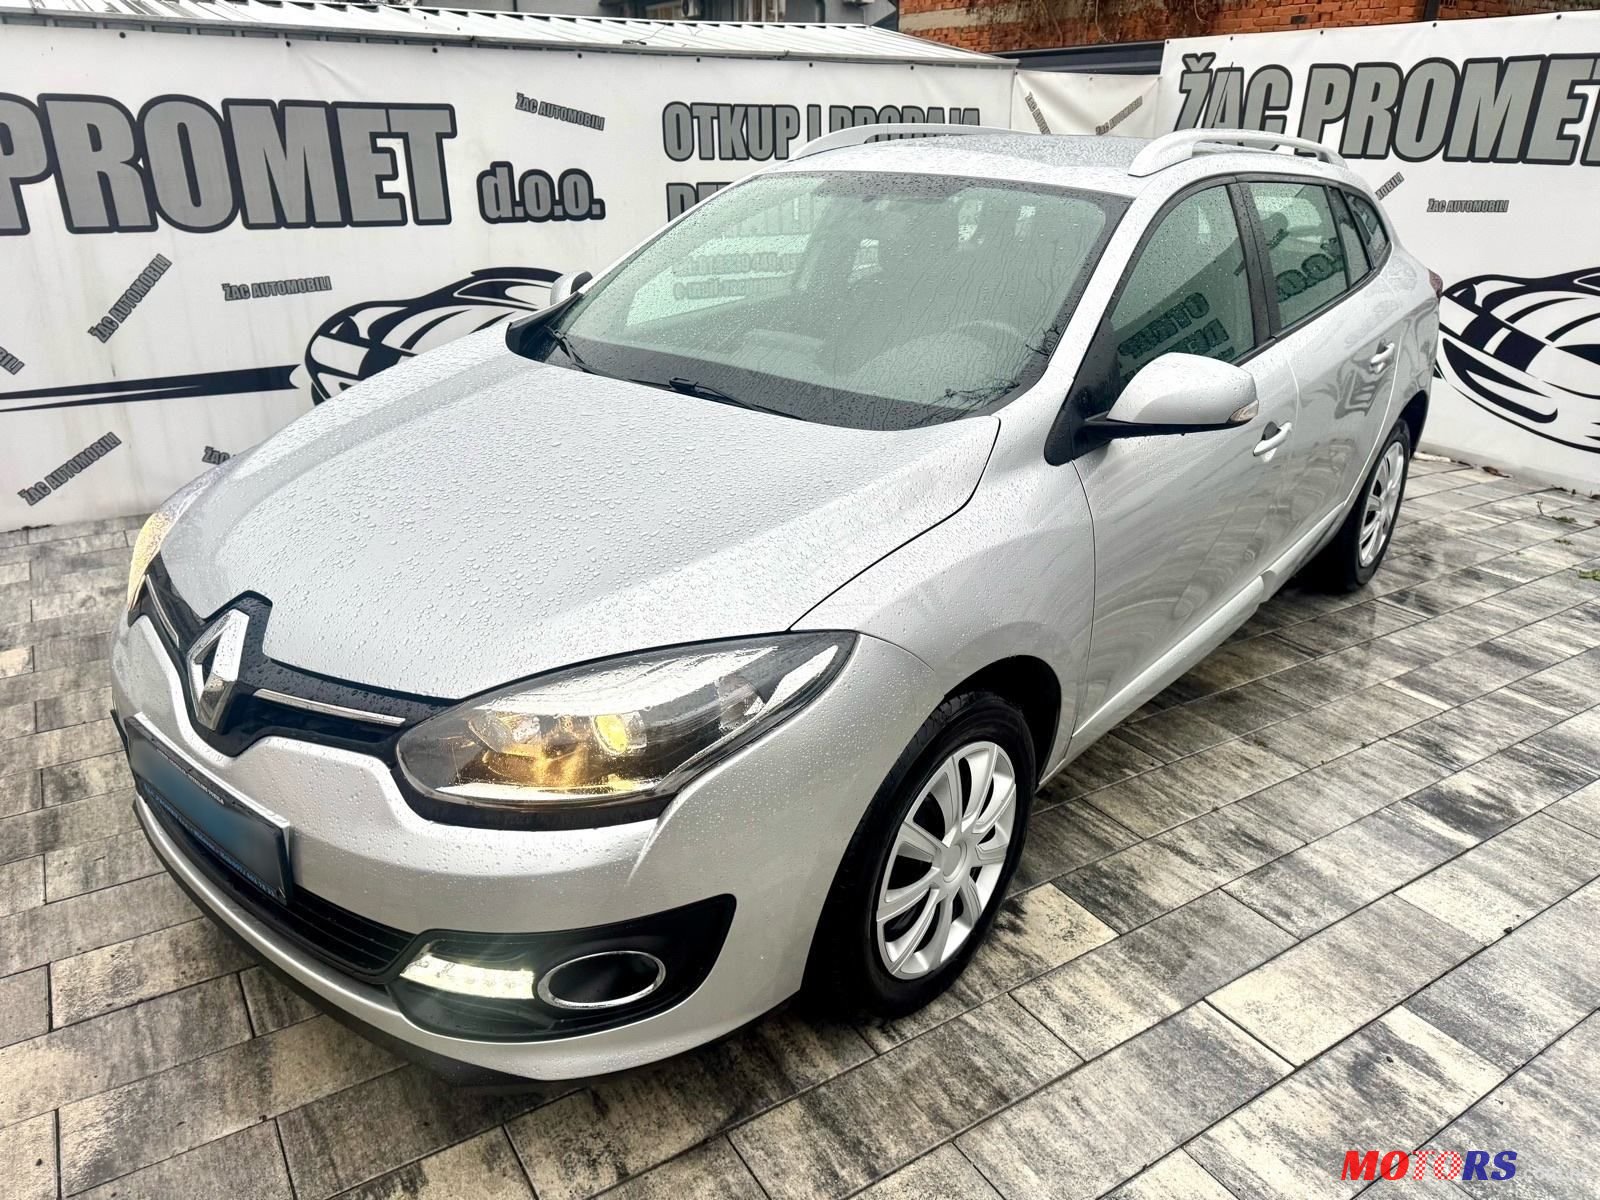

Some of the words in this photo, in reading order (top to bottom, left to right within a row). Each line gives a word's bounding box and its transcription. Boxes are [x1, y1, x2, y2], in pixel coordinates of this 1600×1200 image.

[538, 101, 605, 131] AUTOMOBILI
[662, 101, 800, 161] OTKUP
[1294, 53, 1600, 167] PROME
[0, 92, 457, 236] PROMET
[476, 160, 606, 224] d.o.o.
[1446, 200, 1510, 213] AUTOMOBILI
[108, 253, 173, 324] AUTOMOBILI
[251, 276, 332, 298] AUTOMOBILI
[44, 431, 122, 490] AUTOMOBILI
